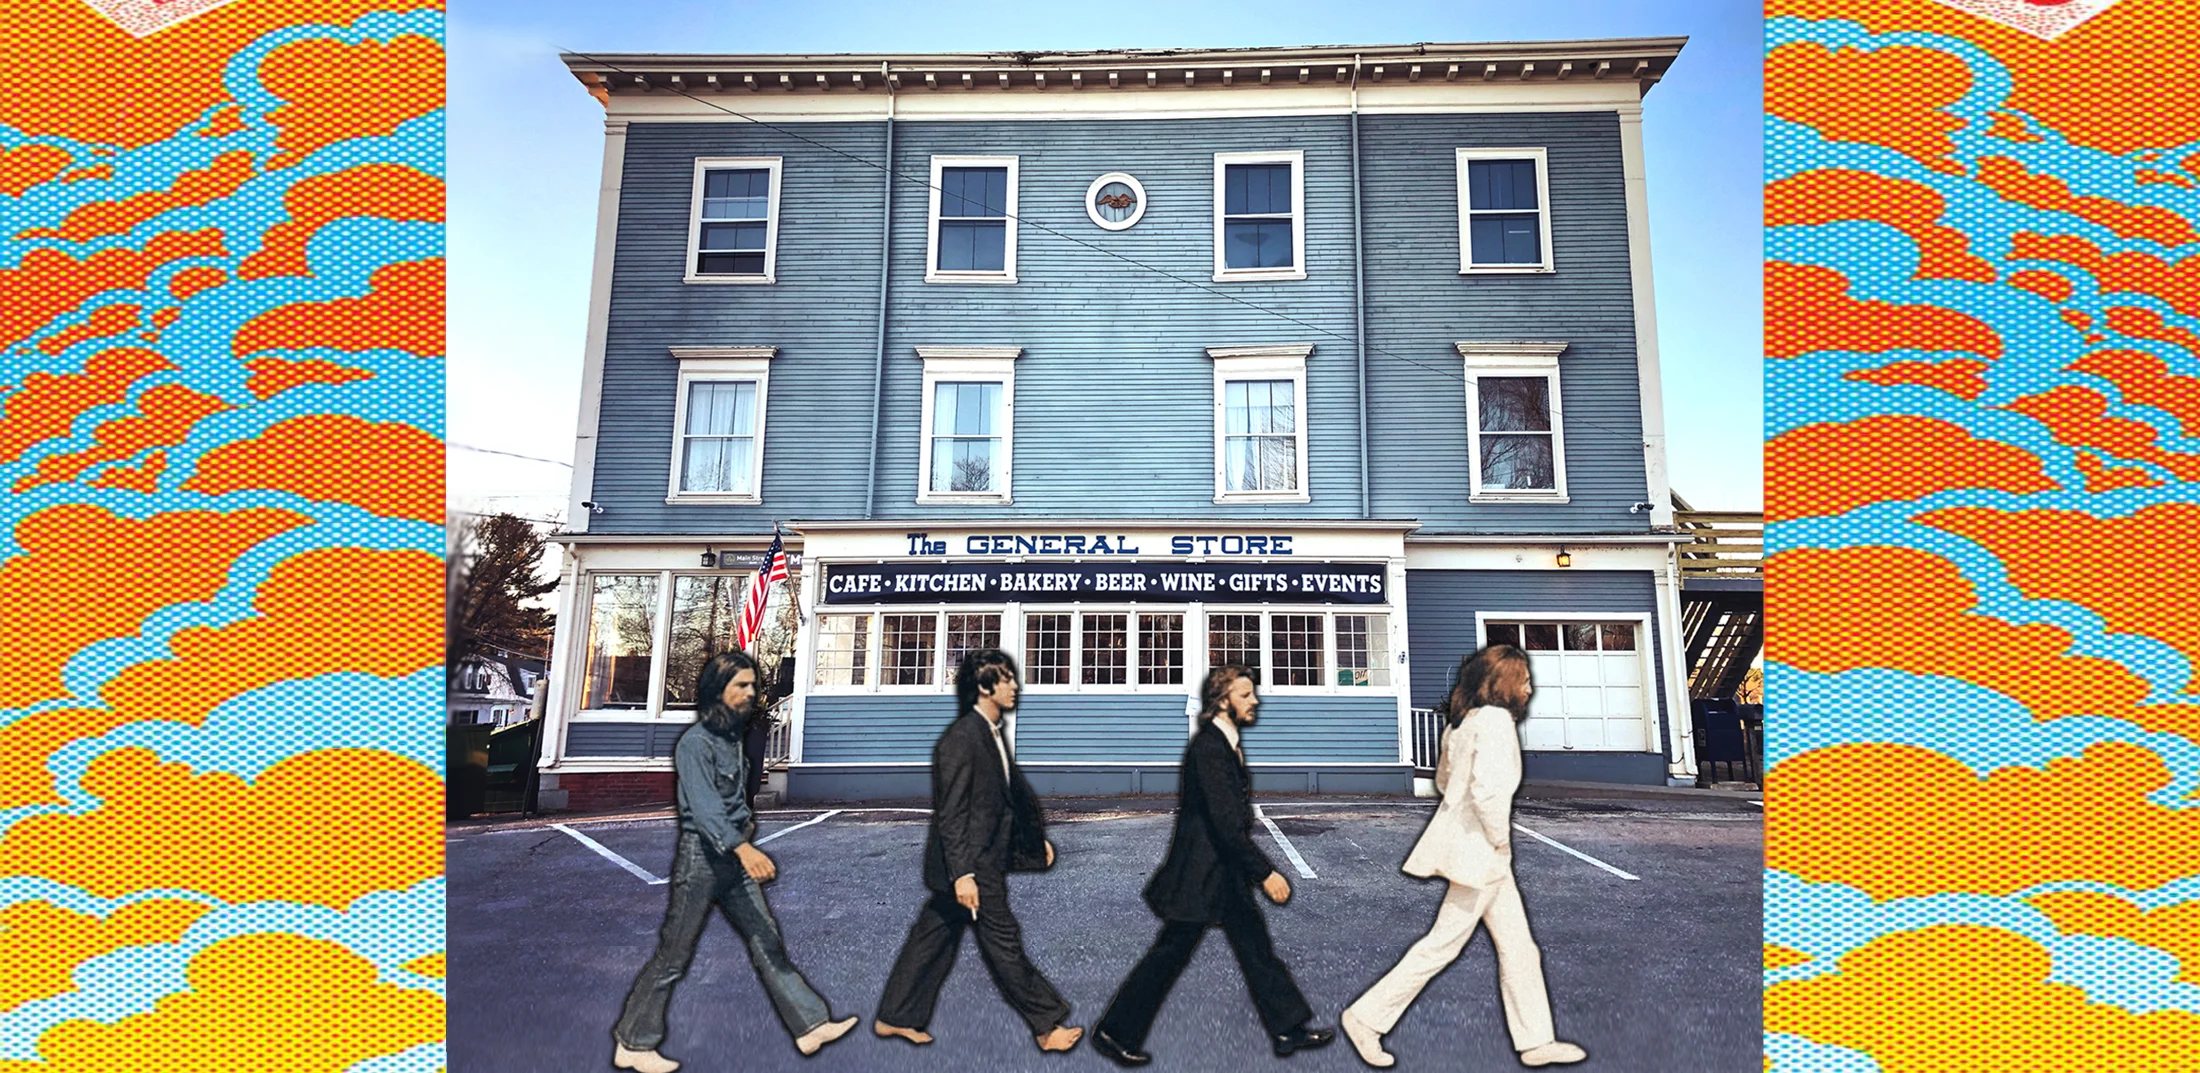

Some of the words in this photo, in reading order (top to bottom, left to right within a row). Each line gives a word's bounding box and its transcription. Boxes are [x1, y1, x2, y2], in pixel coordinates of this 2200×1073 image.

[907, 533, 946, 555] The
[967, 536, 1138, 555] GENERAL
[1172, 535, 1292, 554] STORE
[829, 575, 881, 592] CAFE
[894, 574, 986, 591] KITCHEN
[999, 574, 1081, 591] BAKERY
[1095, 574, 1146, 590] BEER
[1161, 574, 1215, 591] WINE
[1229, 574, 1287, 591] GIFTS
[1301, 575, 1381, 593] EVENTS
